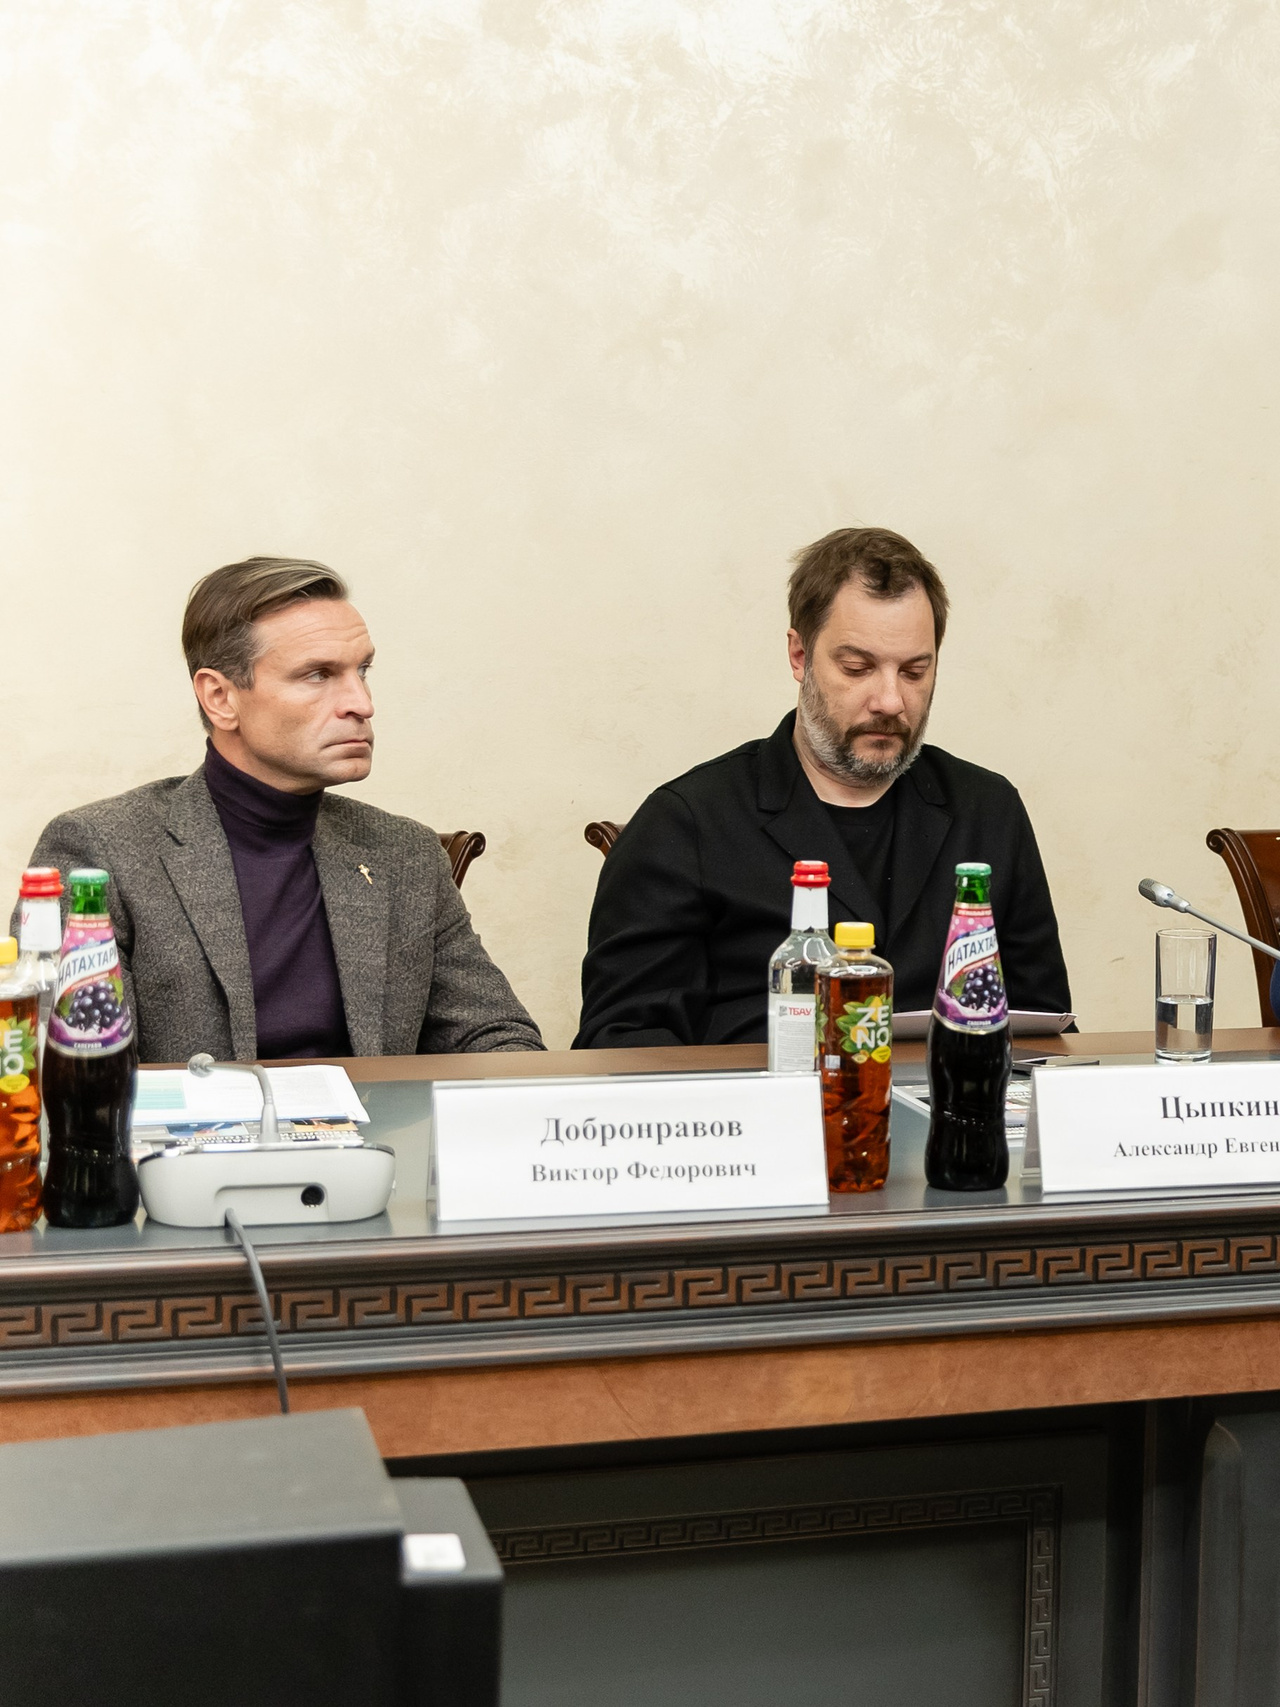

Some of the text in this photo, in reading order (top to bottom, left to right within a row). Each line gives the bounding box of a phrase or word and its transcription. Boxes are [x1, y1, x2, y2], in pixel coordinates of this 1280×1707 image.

[788, 1006, 812, 1016] ТБАУ
[1159, 1094, 1280, 1124] Цыпкин
[539, 1116, 744, 1148] Добронравов
[1112, 1141, 1219, 1159] Александр
[531, 1160, 758, 1186] Виктор Федорович
